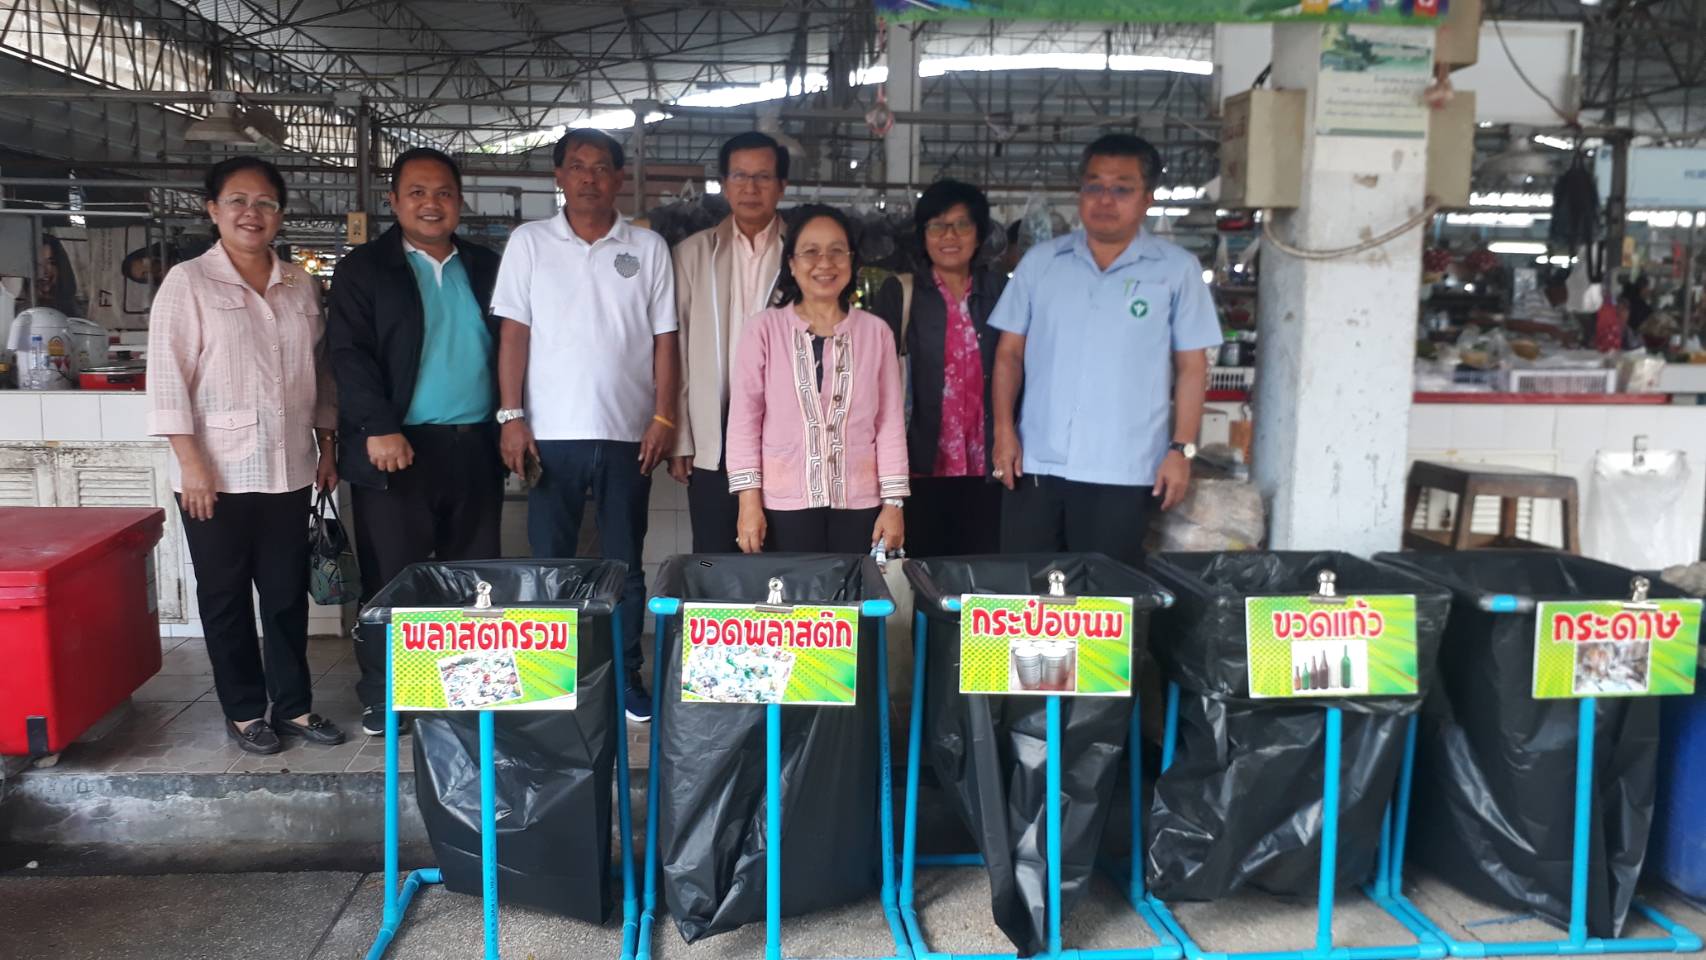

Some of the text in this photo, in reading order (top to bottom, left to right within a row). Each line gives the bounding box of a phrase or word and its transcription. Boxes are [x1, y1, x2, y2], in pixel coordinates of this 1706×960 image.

[402, 620, 568, 650] พลาสตกรวม
[972, 599, 1123, 638] กระป๋องนม
[1273, 600, 1383, 638] ขวดแก้ว
[1554, 612, 1682, 641] กระดาษ
